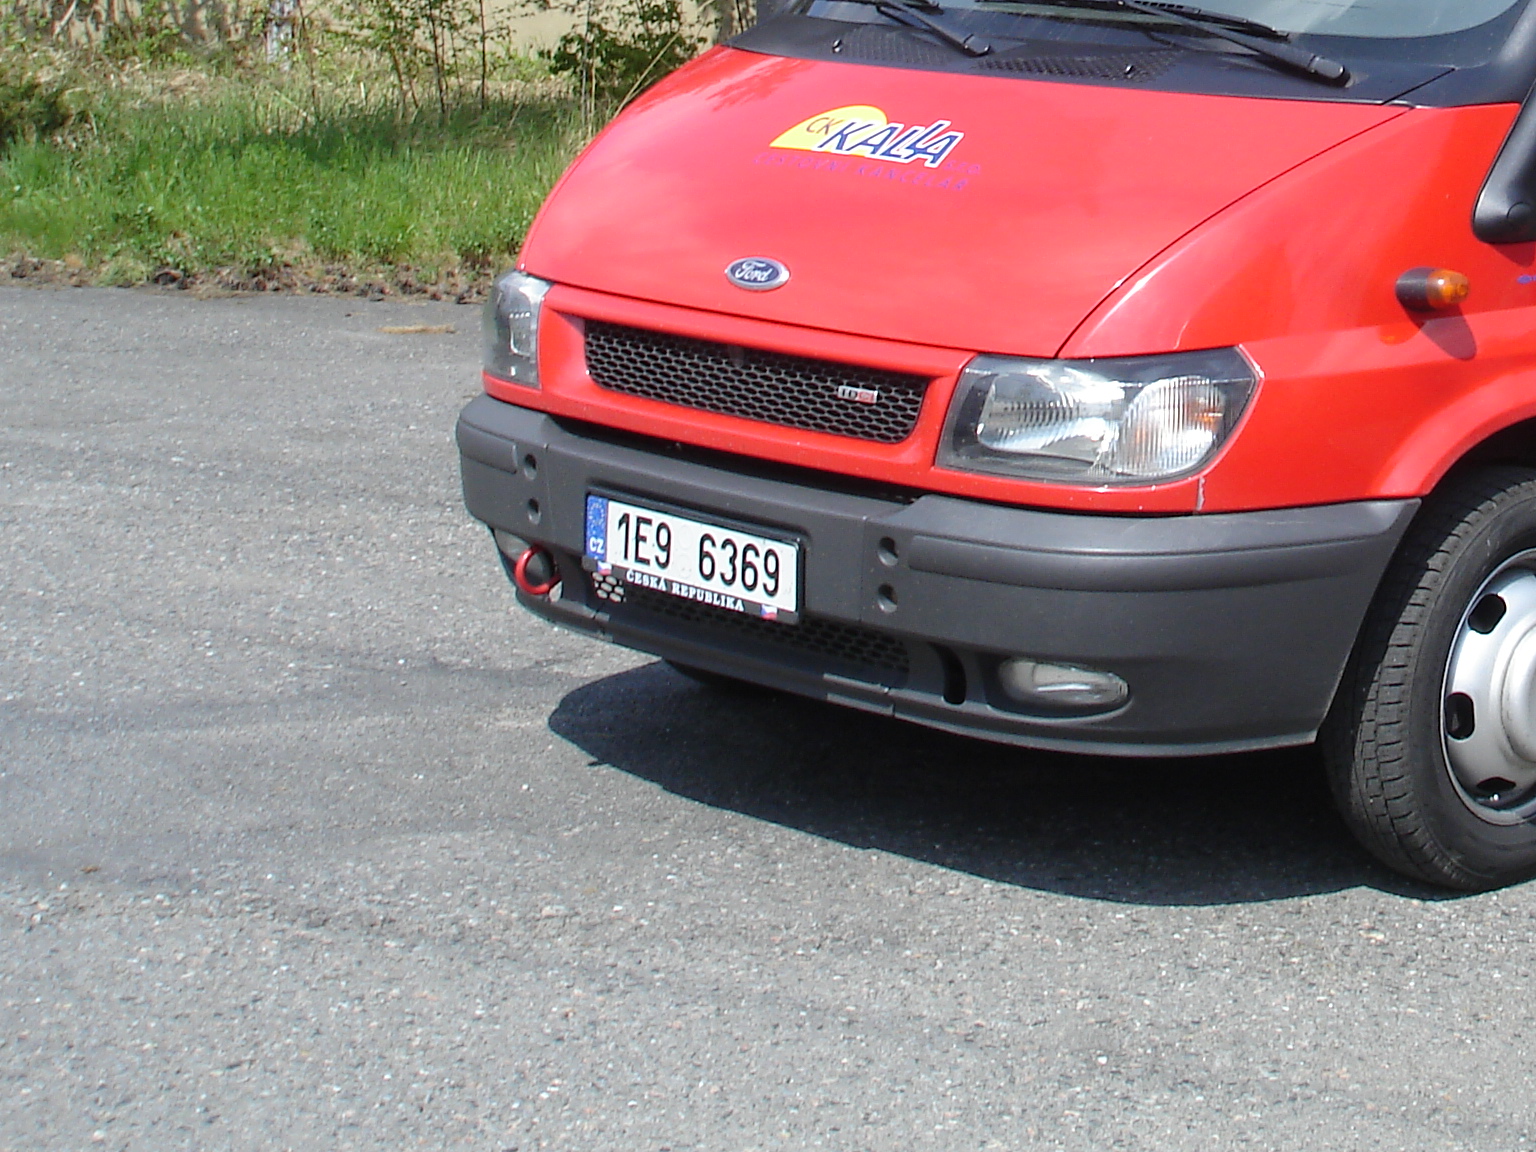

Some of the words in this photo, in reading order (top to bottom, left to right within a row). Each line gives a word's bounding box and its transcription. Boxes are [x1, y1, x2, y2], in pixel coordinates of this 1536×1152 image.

[805, 117, 843, 136] CK
[811, 119, 965, 168] KALLA
[735, 260, 774, 282] Ford
[589, 536, 605, 555] CZ
[617, 512, 672, 570] 1E9
[699, 532, 780, 598] 6369
[626, 568, 667, 592] ČESKÁ
[671, 581, 744, 612] REPUBLIKA
